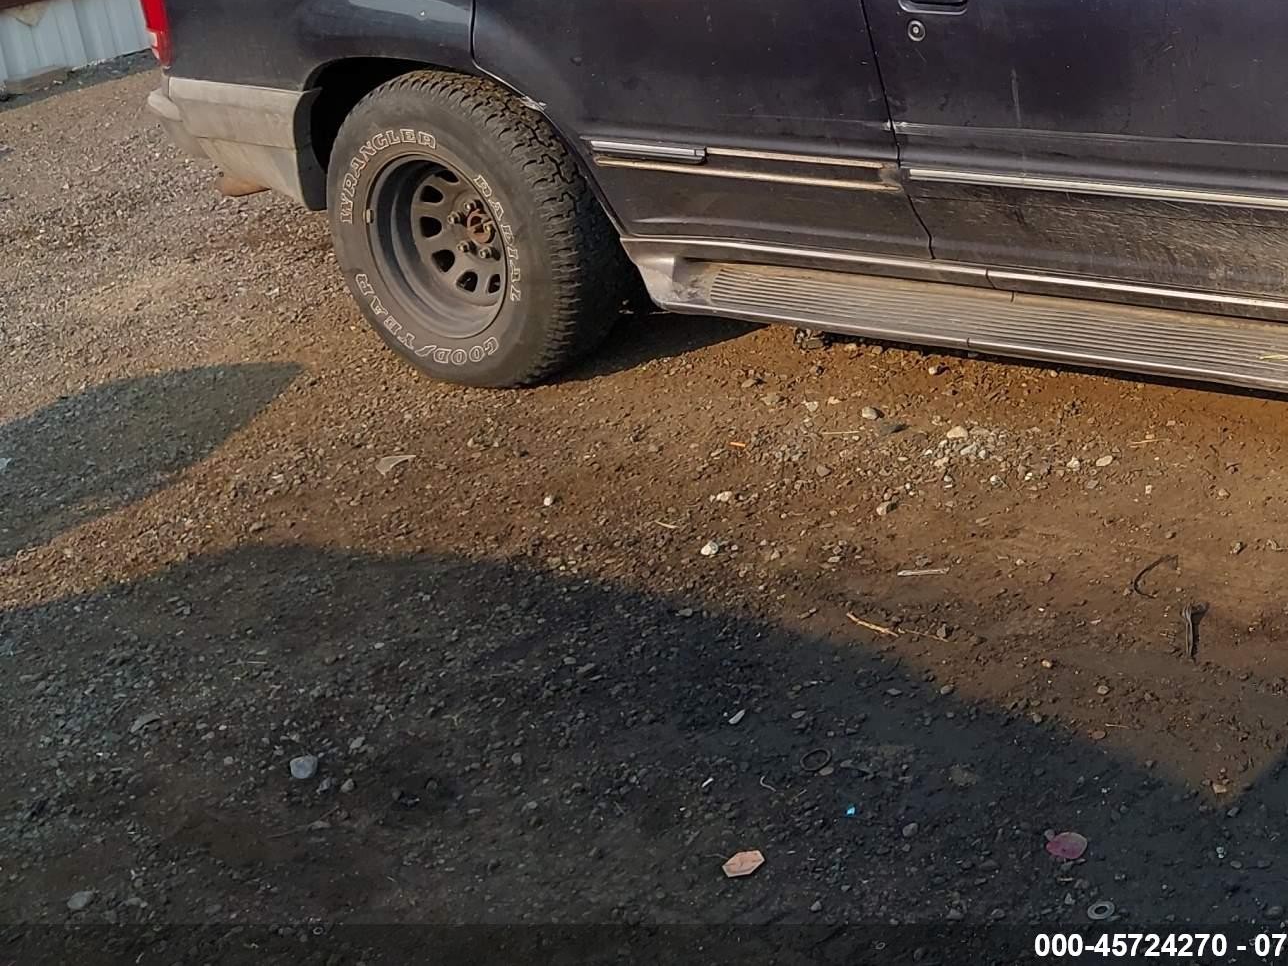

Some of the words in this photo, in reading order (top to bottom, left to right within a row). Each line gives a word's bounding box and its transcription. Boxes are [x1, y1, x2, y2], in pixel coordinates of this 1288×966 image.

[340, 128, 437, 225] WRANGLER
[473, 174, 521, 302] RADIAL
[355, 273, 500, 366] GOODYEAR
